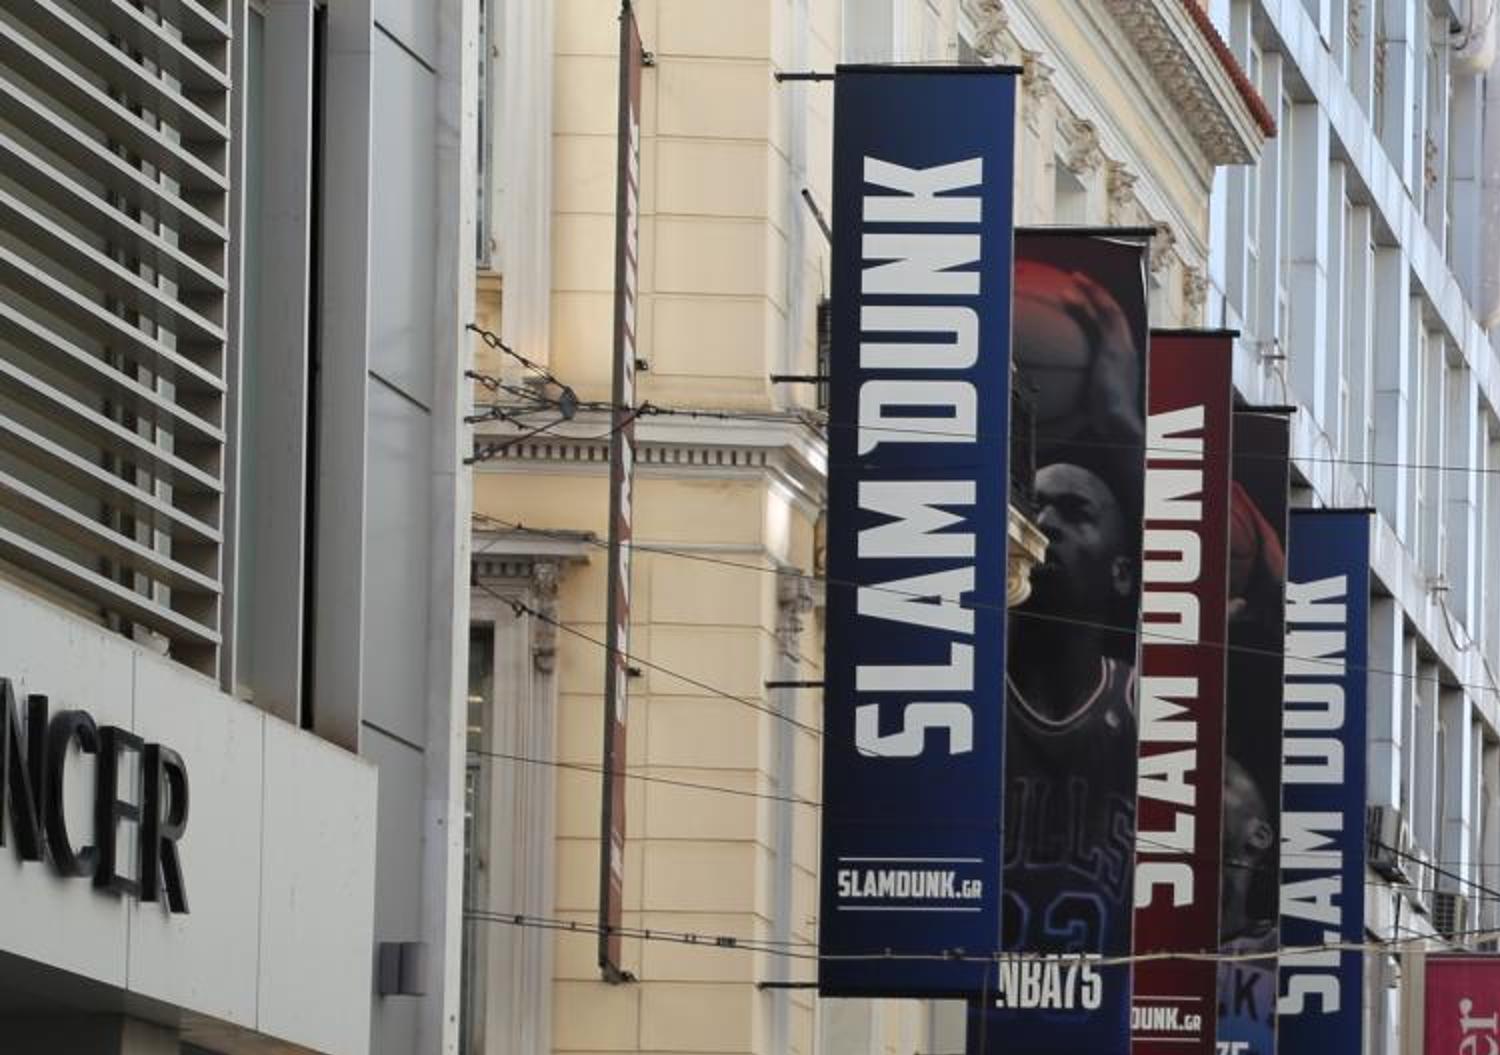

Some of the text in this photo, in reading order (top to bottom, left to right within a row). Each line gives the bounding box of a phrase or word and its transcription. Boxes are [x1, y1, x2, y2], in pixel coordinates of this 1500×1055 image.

[855, 155, 983, 758] SLAM DUNK
[995, 953, 1103, 1011] NBA75
